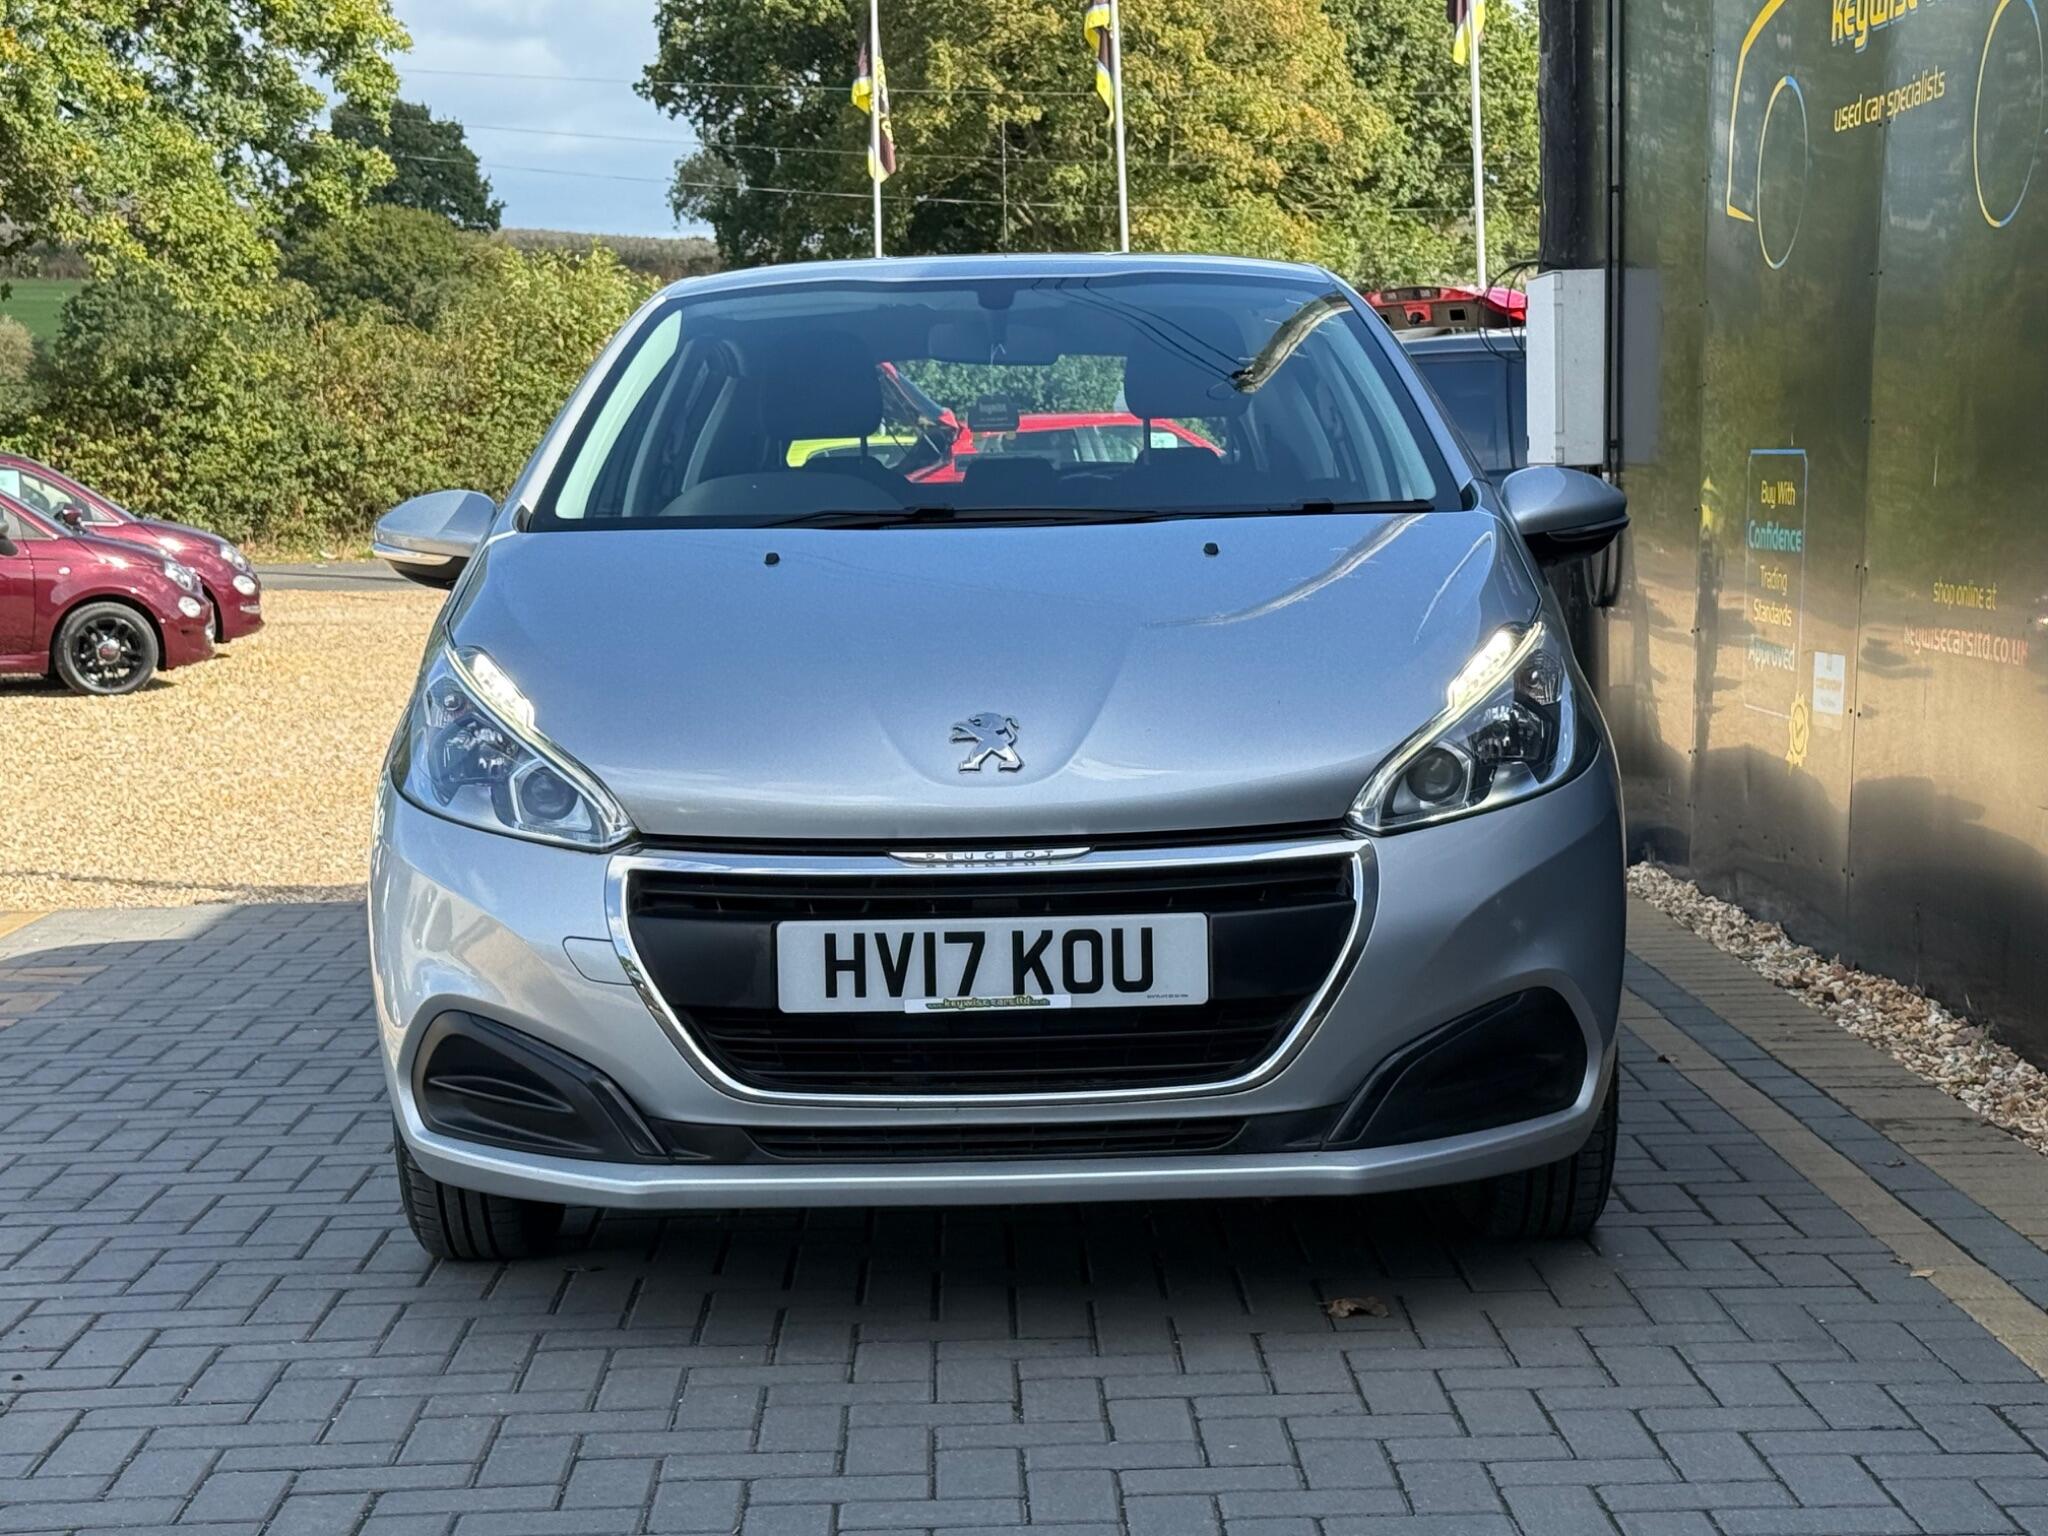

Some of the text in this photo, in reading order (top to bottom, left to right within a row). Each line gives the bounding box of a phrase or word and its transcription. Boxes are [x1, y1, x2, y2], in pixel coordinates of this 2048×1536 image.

[1834, 65, 1946, 132] used car specialists
[1761, 479, 1796, 509] Buy With
[1748, 519, 1802, 552] Confidence
[1760, 565, 1788, 596] Trading
[1933, 576, 1998, 610] shop online at
[1753, 598, 1793, 627] Standards
[1747, 633, 1796, 672] Approved
[1903, 627, 2029, 666] keywisecarsltd.co.uk
[926, 850, 1054, 860] PEUGEOT
[824, 927, 1154, 999] HV17 KOU
